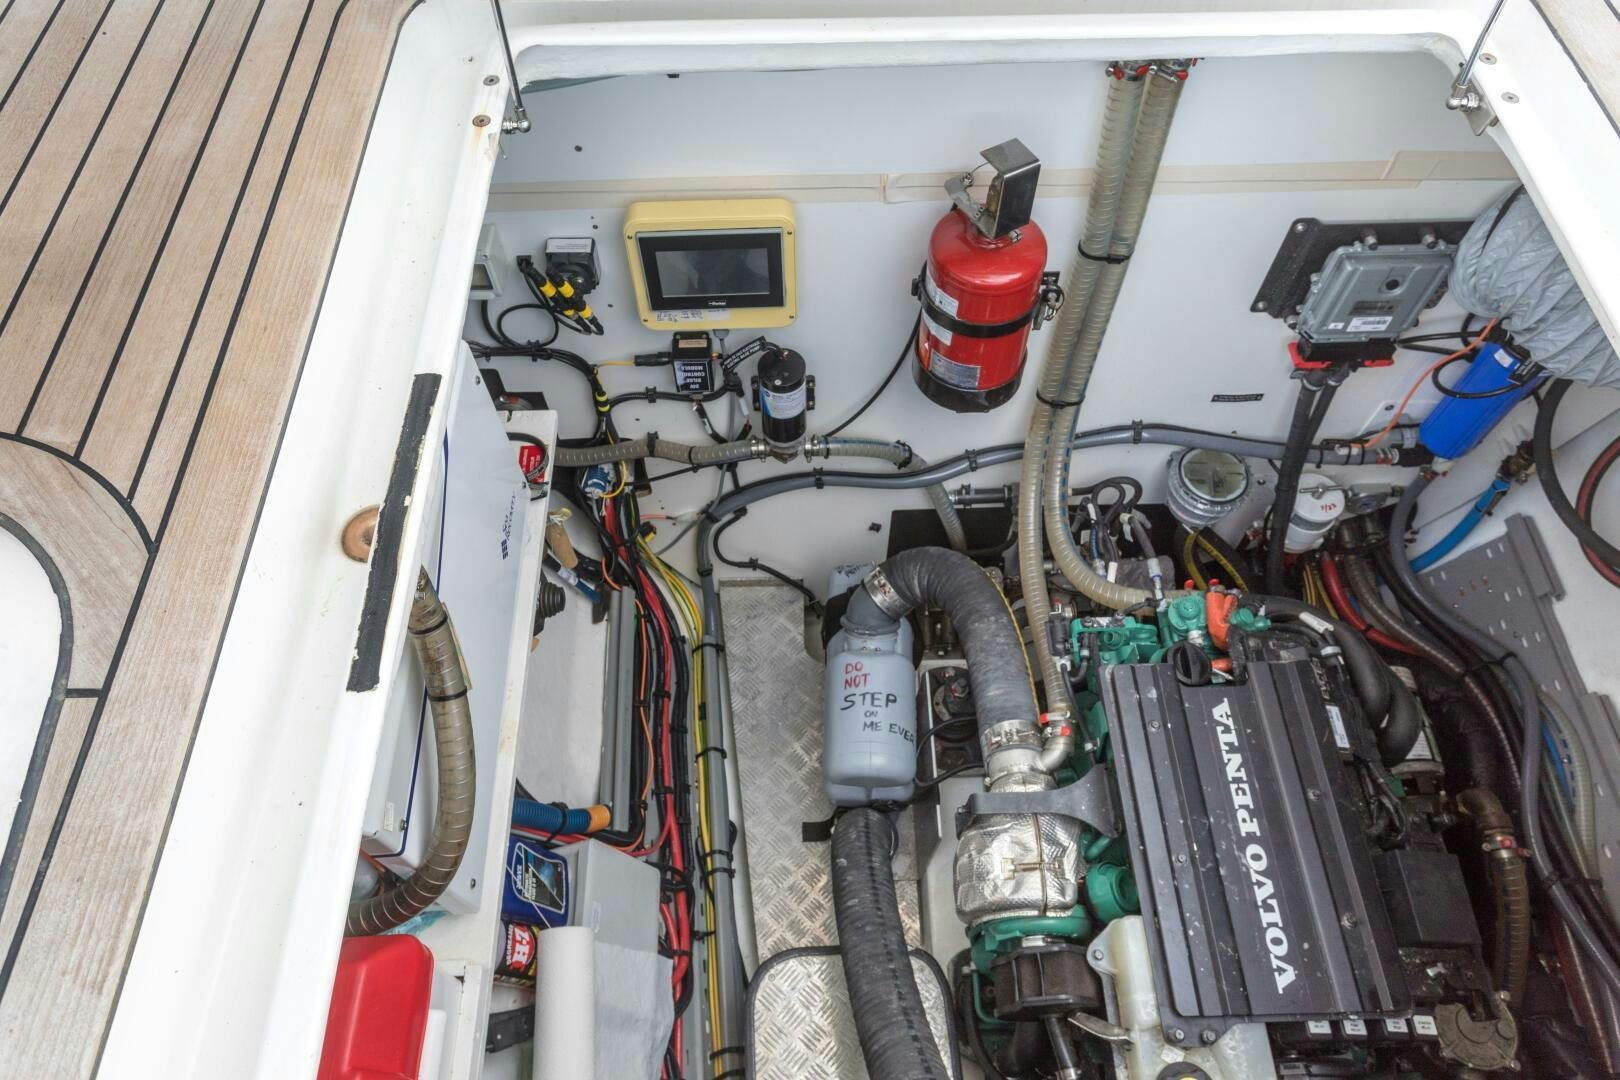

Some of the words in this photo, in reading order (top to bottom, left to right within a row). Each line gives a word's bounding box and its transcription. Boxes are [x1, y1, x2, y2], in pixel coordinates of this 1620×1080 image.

[844, 661, 864, 675] DO
[844, 673, 871, 690] NOT
[840, 691, 898, 711] STEP
[864, 710, 879, 718] ON
[862, 720, 883, 732] ME
[1211, 697, 1261, 837] PENTA
[1245, 843, 1297, 995] VOLVO
